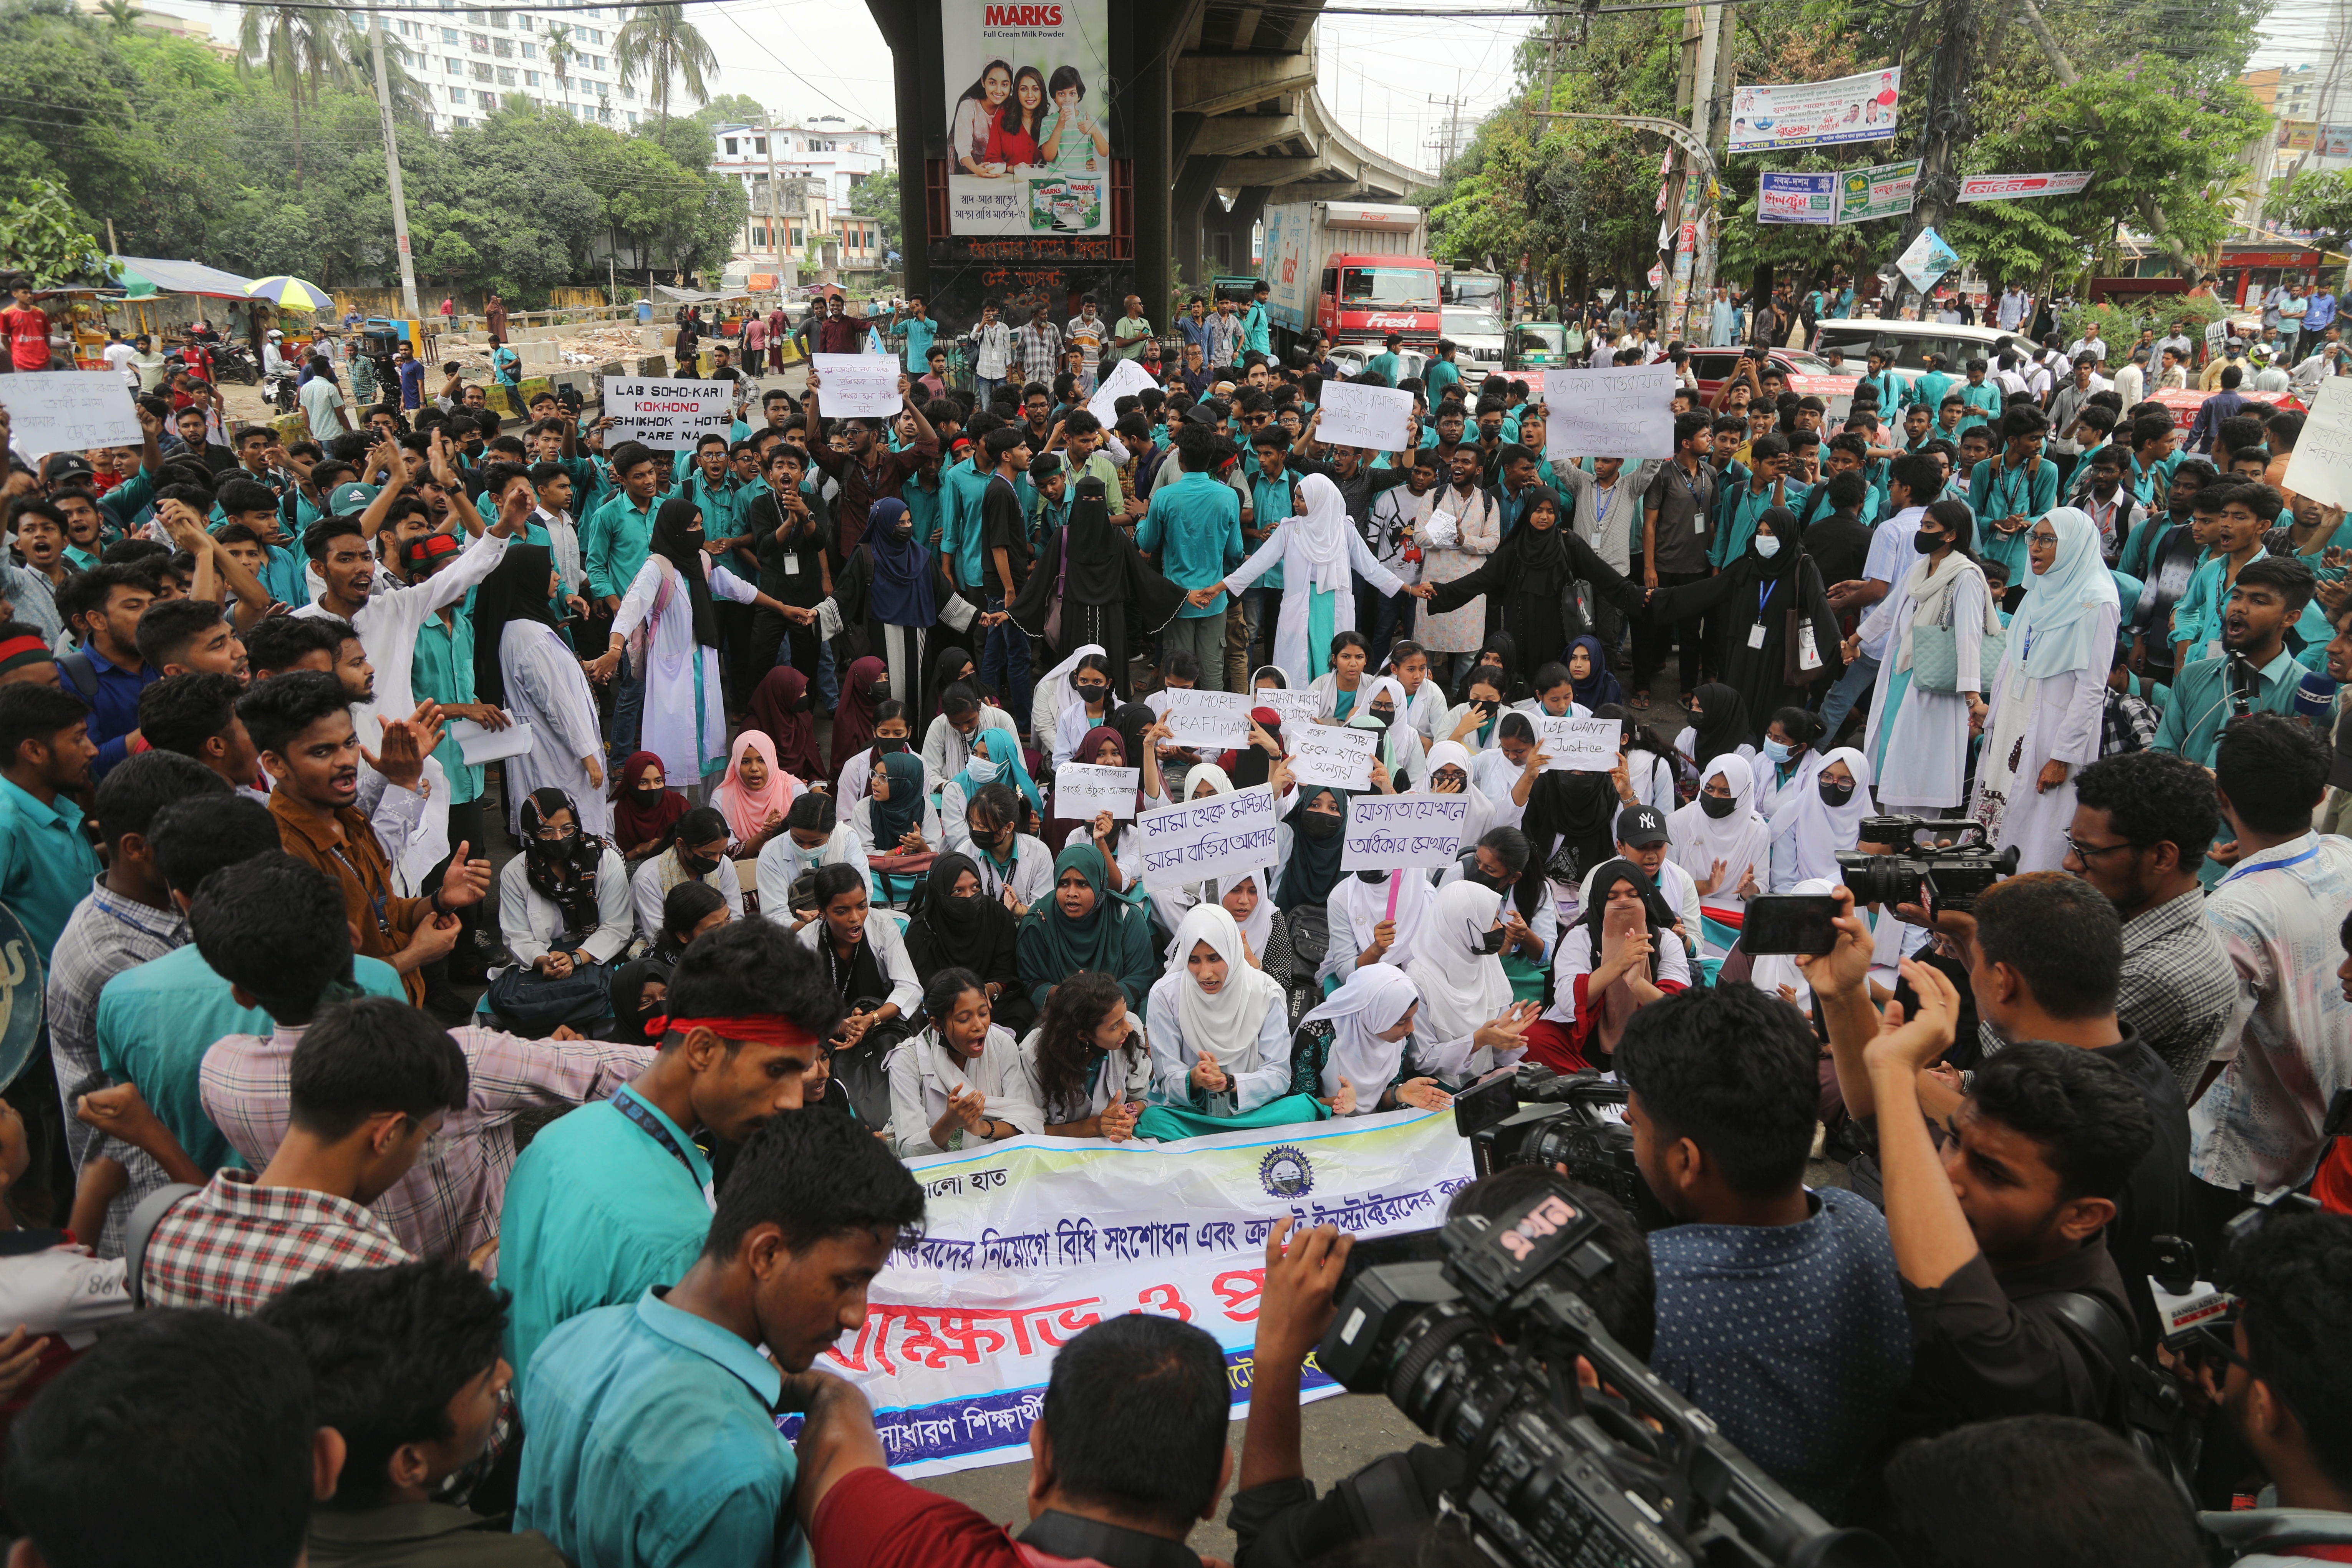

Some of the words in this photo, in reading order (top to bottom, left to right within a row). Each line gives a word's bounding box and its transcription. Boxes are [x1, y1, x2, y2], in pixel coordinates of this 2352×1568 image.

[984, 5, 1063, 27] MARKS
[1773, 176, 1810, 187] নবম-দশম
[1873, 184, 1894, 195] মনছুর
[1895, 181, 1912, 191] স্যার
[1967, 181, 2025, 193] মেরিন
[2048, 177, 2086, 187] ইউনিটি
[960, 195, 974, 205] স্বাদ
[976, 195, 992, 204] আর
[953, 210, 974, 220] আস্থা
[975, 206, 991, 220] রাখি
[1360, 212, 1389, 221] Fresh
[1031, 240, 1067, 258] পতন
[1071, 236, 1110, 259] দিবস
[1366, 313, 1417, 328] Fresh
[1570, 377, 1597, 393] দফা
[1598, 372, 1670, 391] বাস্তবায়ন
[616, 385, 644, 396] LAB
[651, 386, 723, 398] SOHO-KARI
[635, 401, 699, 413] KOKHONO
[1326, 406, 1351, 419] মানি
[1354, 411, 1368, 424] না
[1583, 398, 1606, 416] না
[614, 416, 674, 426] SHIKHOK
[694, 416, 728, 426] HOTE
[637, 431, 675, 440] PARE
[681, 431, 701, 441] NA
[1172, 693, 1190, 705] NO
[1200, 694, 1238, 709] MORE
[1260, 692, 1293, 705] আমরা
[1169, 716, 1218, 733] CRAFT
[1220, 719, 1250, 737] MAMA
[1543, 720, 1569, 734] WE
[1571, 722, 1613, 735] WANT
[1301, 742, 1329, 756] ভেসে
[1335, 748, 1368, 765] যাবে
[1552, 738, 1606, 753] Justice
[1077, 767, 1091, 776] এর
[1094, 766, 1133, 781] হাতিয়ার
[1085, 782, 1106, 798] উঠুক
[1141, 812, 1187, 837] মামা
[1192, 804, 1226, 827] থেকে
[1229, 792, 1273, 819] মাস্টার
[1356, 802, 1415, 823] যোগ্যতা
[1416, 802, 1468, 821] যেখানে
[1142, 847, 1183, 872] মামা
[1187, 832, 1228, 862] বাড়ির
[1229, 827, 1277, 850] আবদার
[1347, 829, 1409, 854] অধিকার
[1411, 837, 1460, 855] সেখানে
[968, 1169, 1009, 1192] হাত
[980, 1228, 1049, 1272] নিয়োগে
[1056, 1217, 1097, 1265] বিধি
[1102, 1220, 1191, 1262] সংশোধন
[1196, 1222, 1240, 1252] এবং
[2170, 1294, 2225, 1319] BANGLADESH
